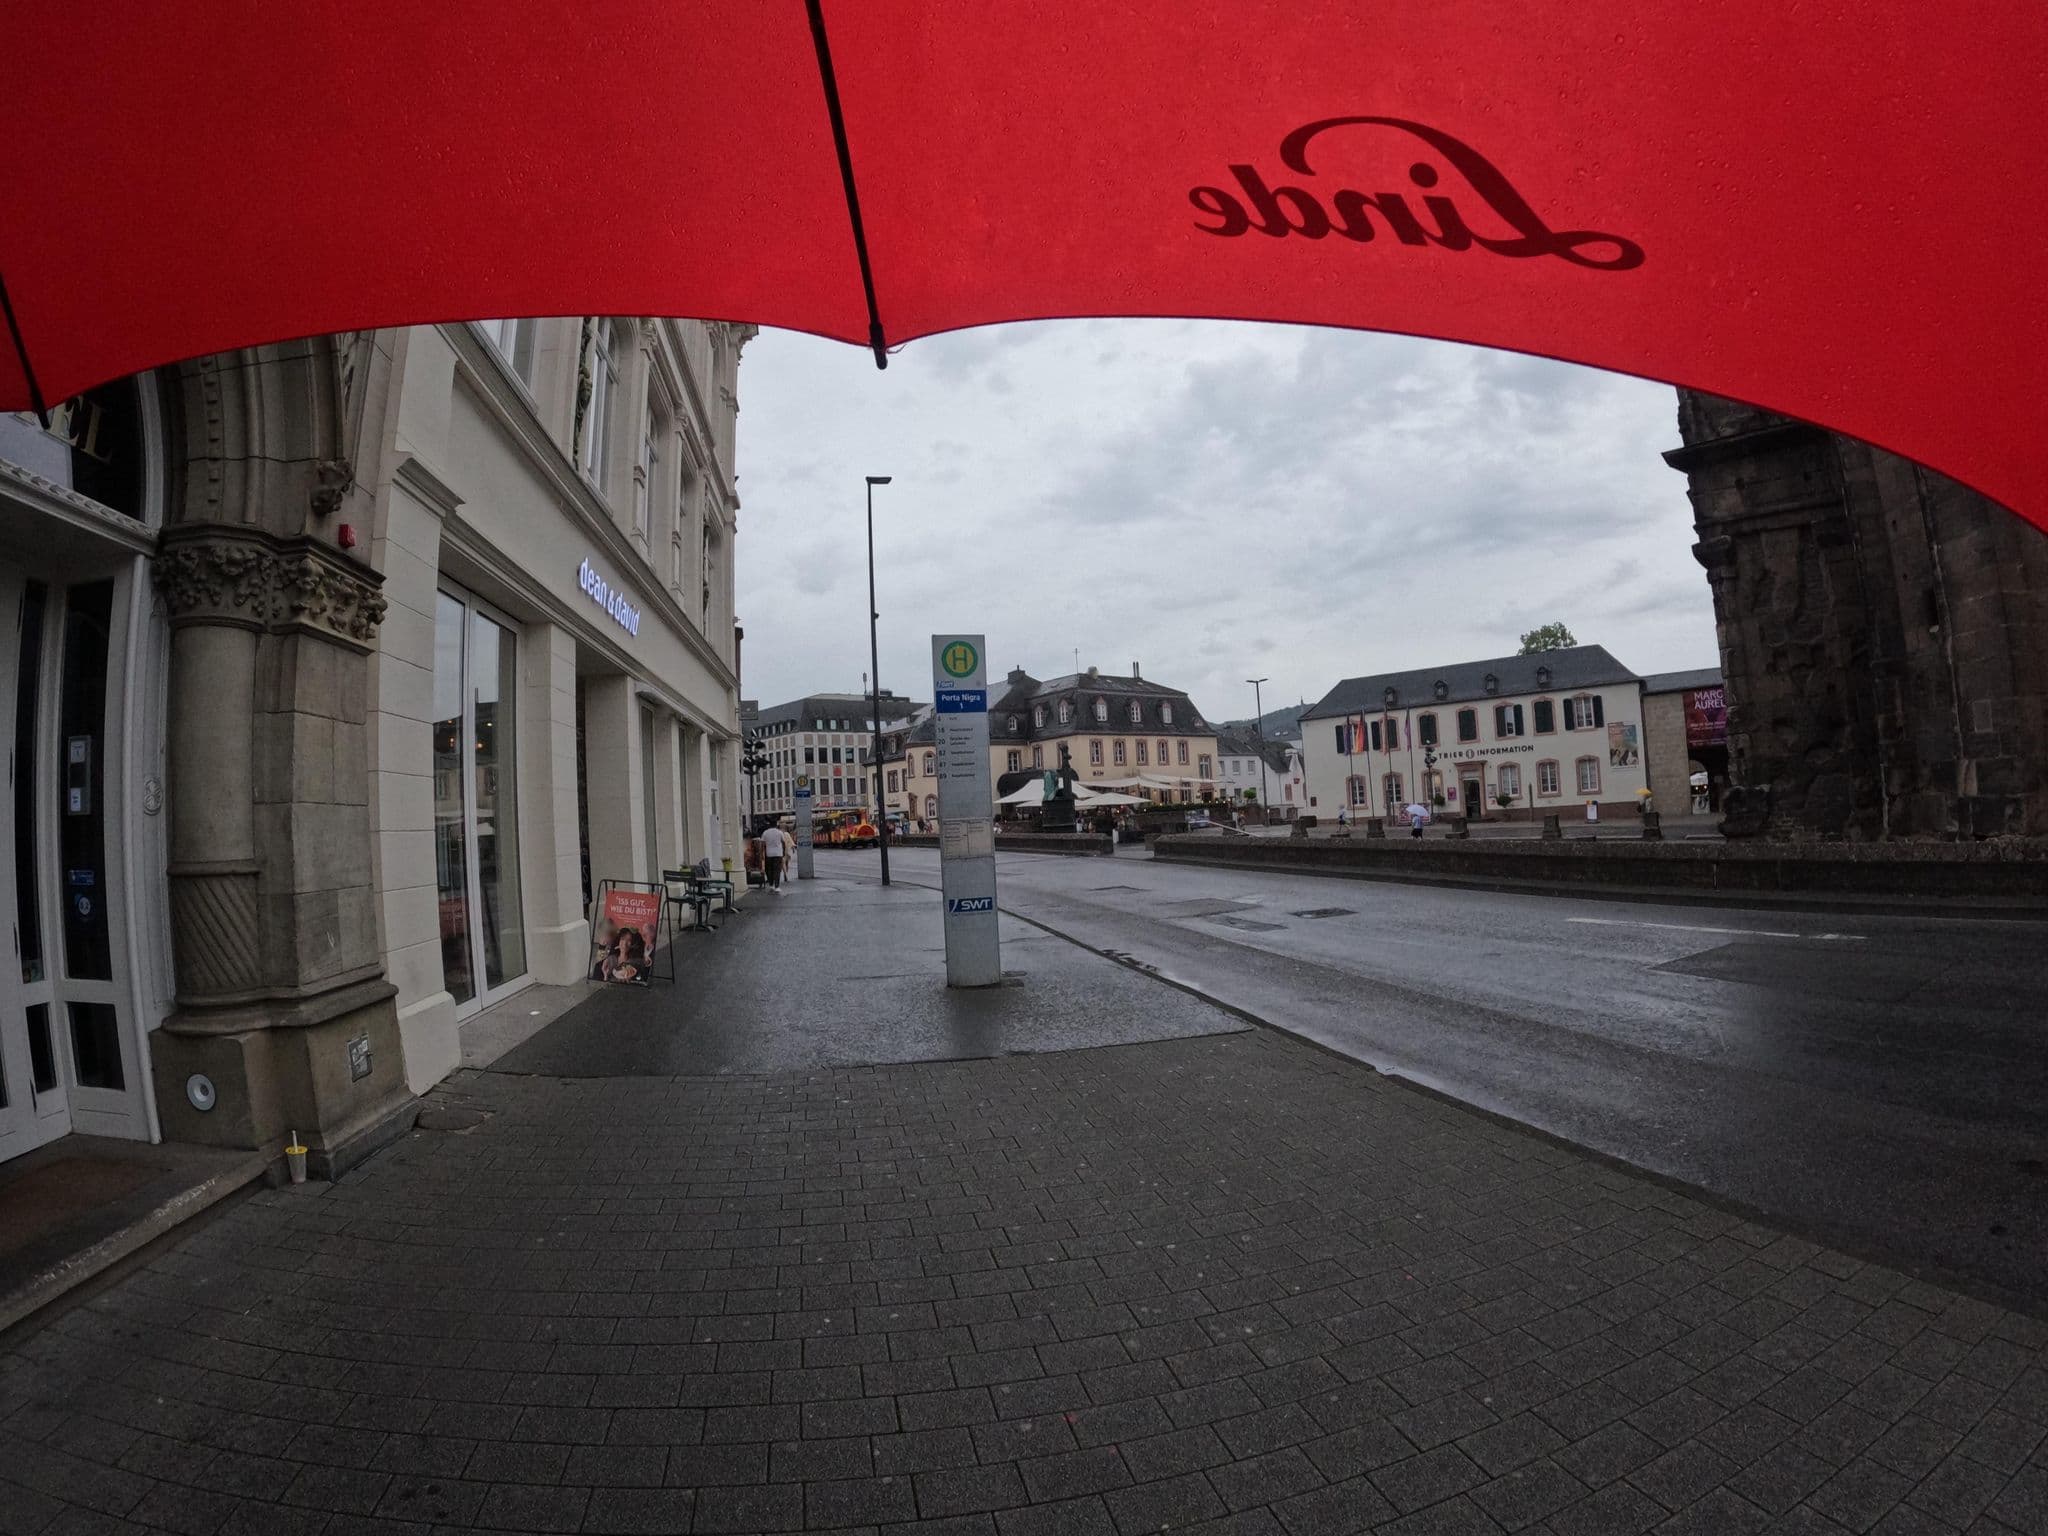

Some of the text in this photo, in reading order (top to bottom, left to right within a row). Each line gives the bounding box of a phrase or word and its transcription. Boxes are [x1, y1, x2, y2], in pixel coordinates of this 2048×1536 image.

[580, 557, 640, 636] dean & david
[952, 648, 968, 671] H
[961, 693, 981, 703] Nigra
[1694, 689, 1724, 700] MARC
[1694, 699, 1727, 710] AUREL
[1477, 744, 1534, 757] INFORMATION
[610, 904, 623, 913] WIE
[624, 906, 635, 914] DU
[961, 899, 991, 910] SWT
